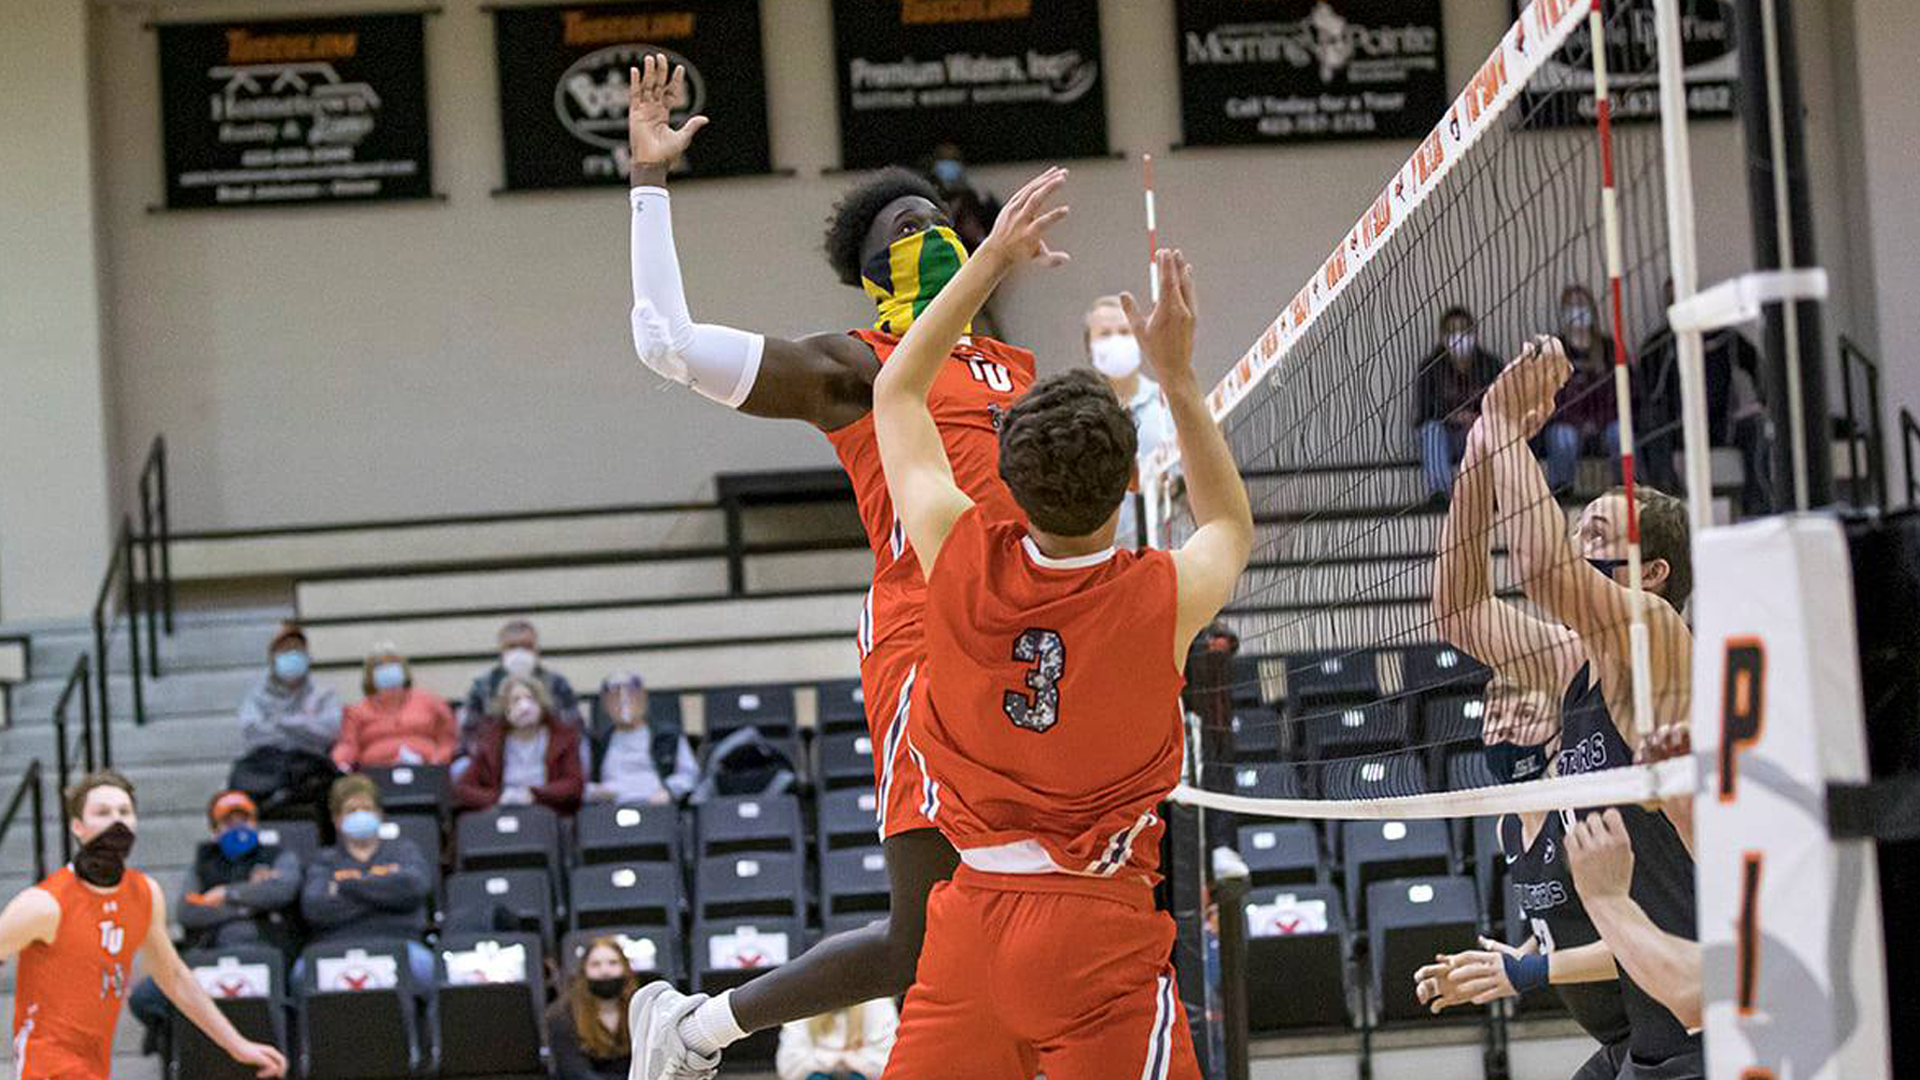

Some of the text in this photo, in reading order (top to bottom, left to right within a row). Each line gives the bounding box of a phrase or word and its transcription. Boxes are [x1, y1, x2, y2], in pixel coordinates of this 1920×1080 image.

[850, 56, 946, 88] Premium
[1226, 97, 1262, 118] Call
[1002, 626, 1066, 735] 3
[99, 920, 124, 955] TU
